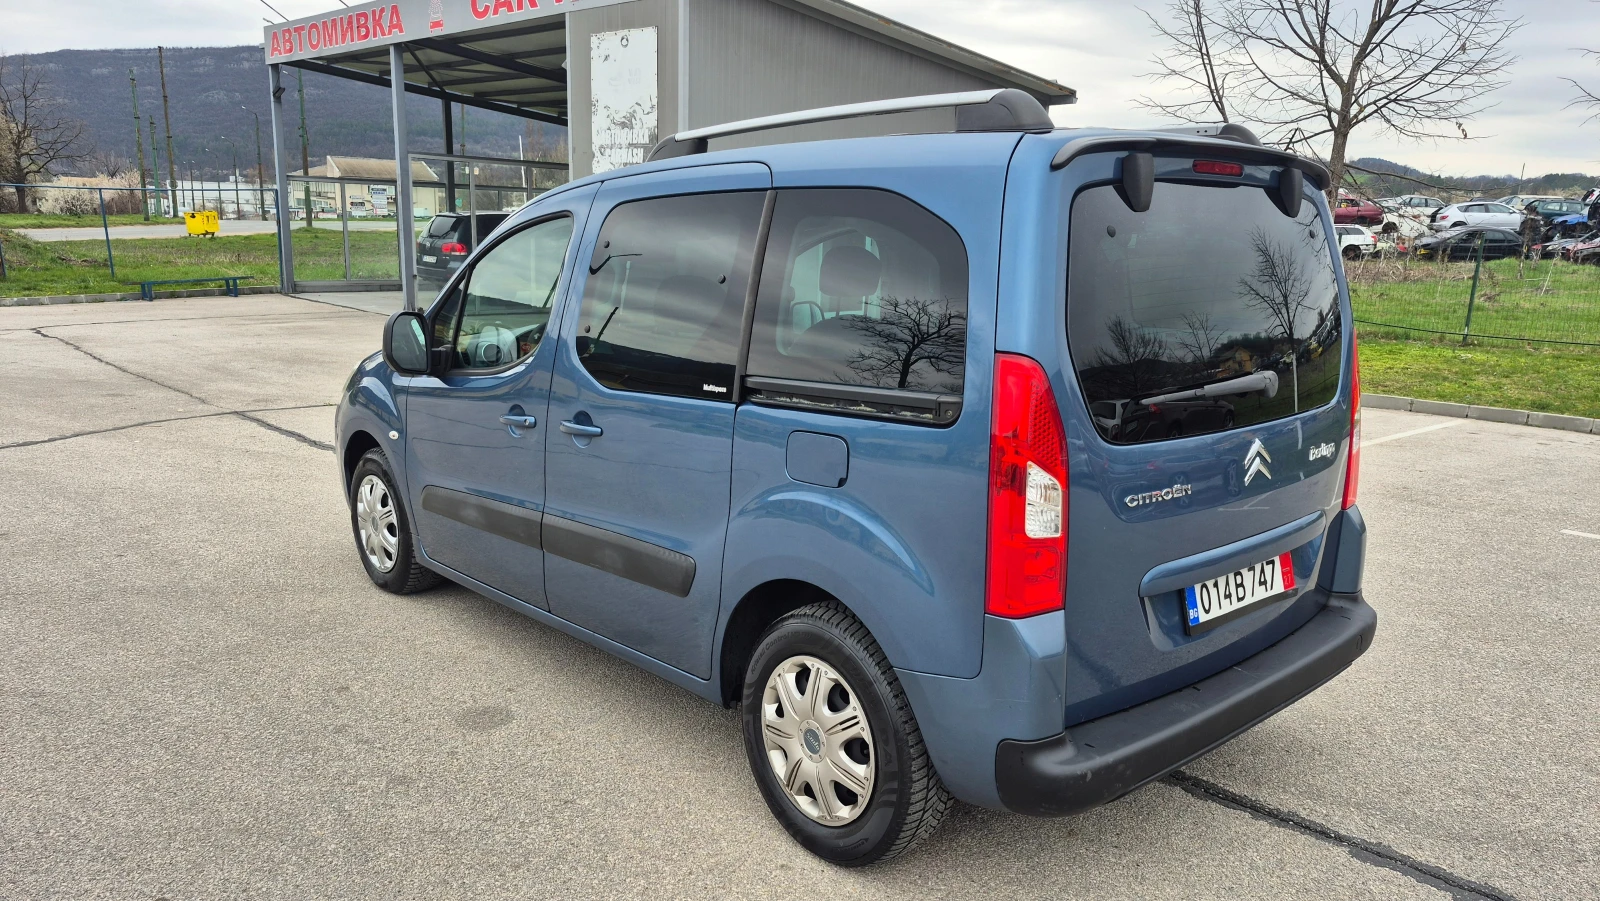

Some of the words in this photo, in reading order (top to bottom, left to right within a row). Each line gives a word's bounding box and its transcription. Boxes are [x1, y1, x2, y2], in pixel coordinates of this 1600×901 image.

[270, 4, 405, 58] АВТОМИВКА
[1124, 484, 1192, 507] CITROËN
[1189, 608, 1198, 620] BG
